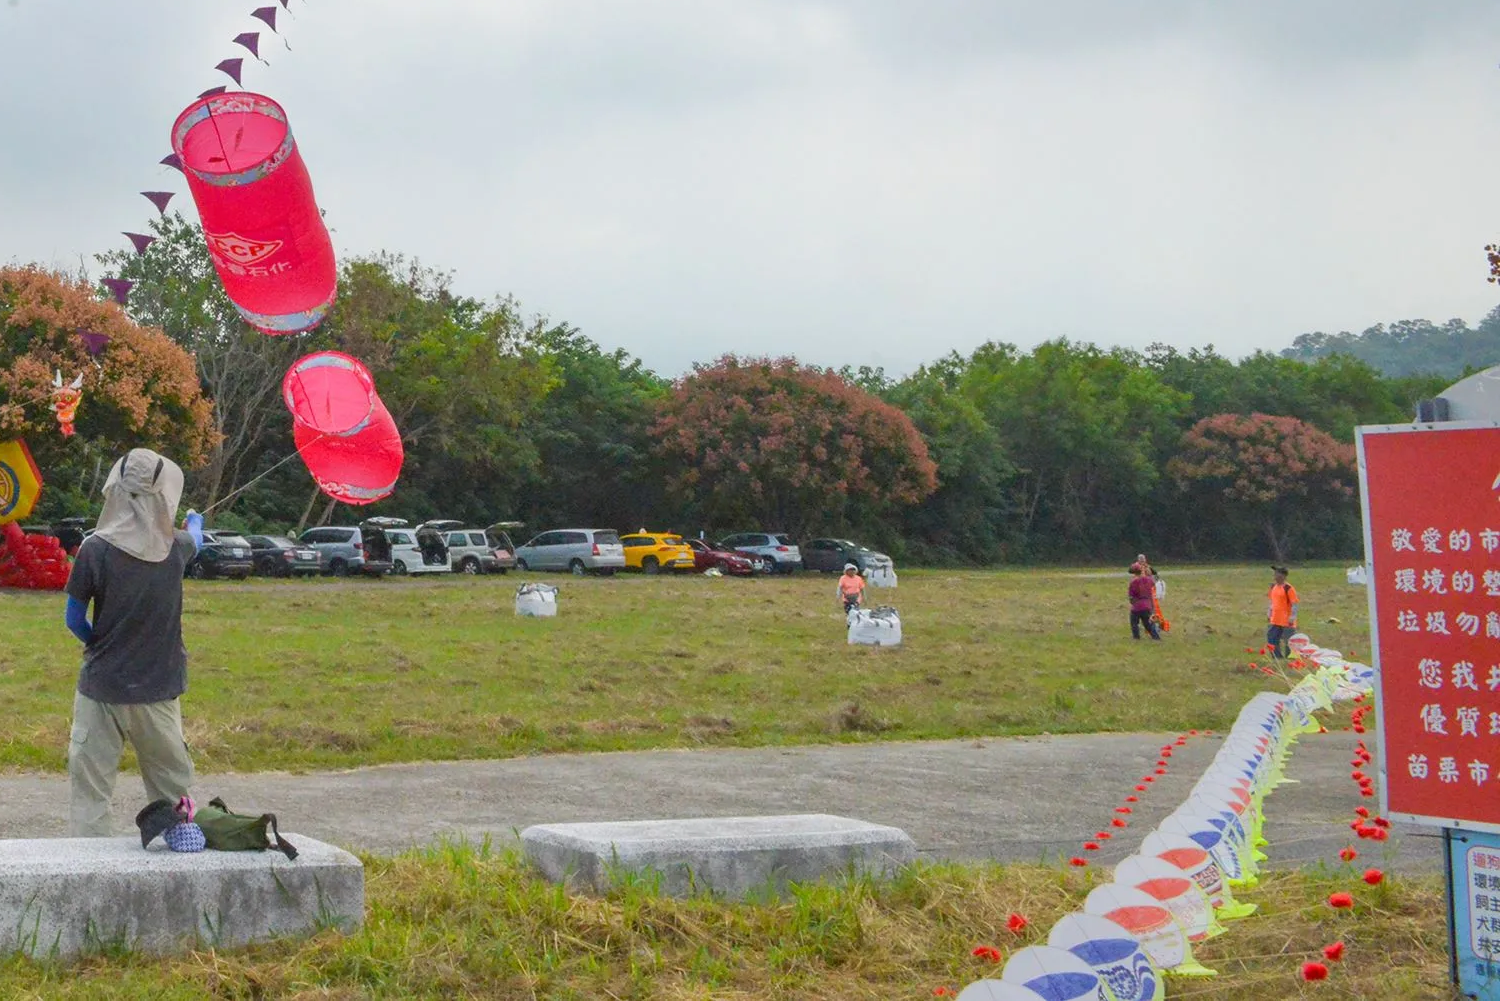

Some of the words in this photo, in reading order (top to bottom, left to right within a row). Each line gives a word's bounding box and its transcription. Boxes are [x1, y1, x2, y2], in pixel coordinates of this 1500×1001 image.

[1391, 526, 1500, 554] 敬愛的市
[1408, 753, 1500, 787] 苗栗市
